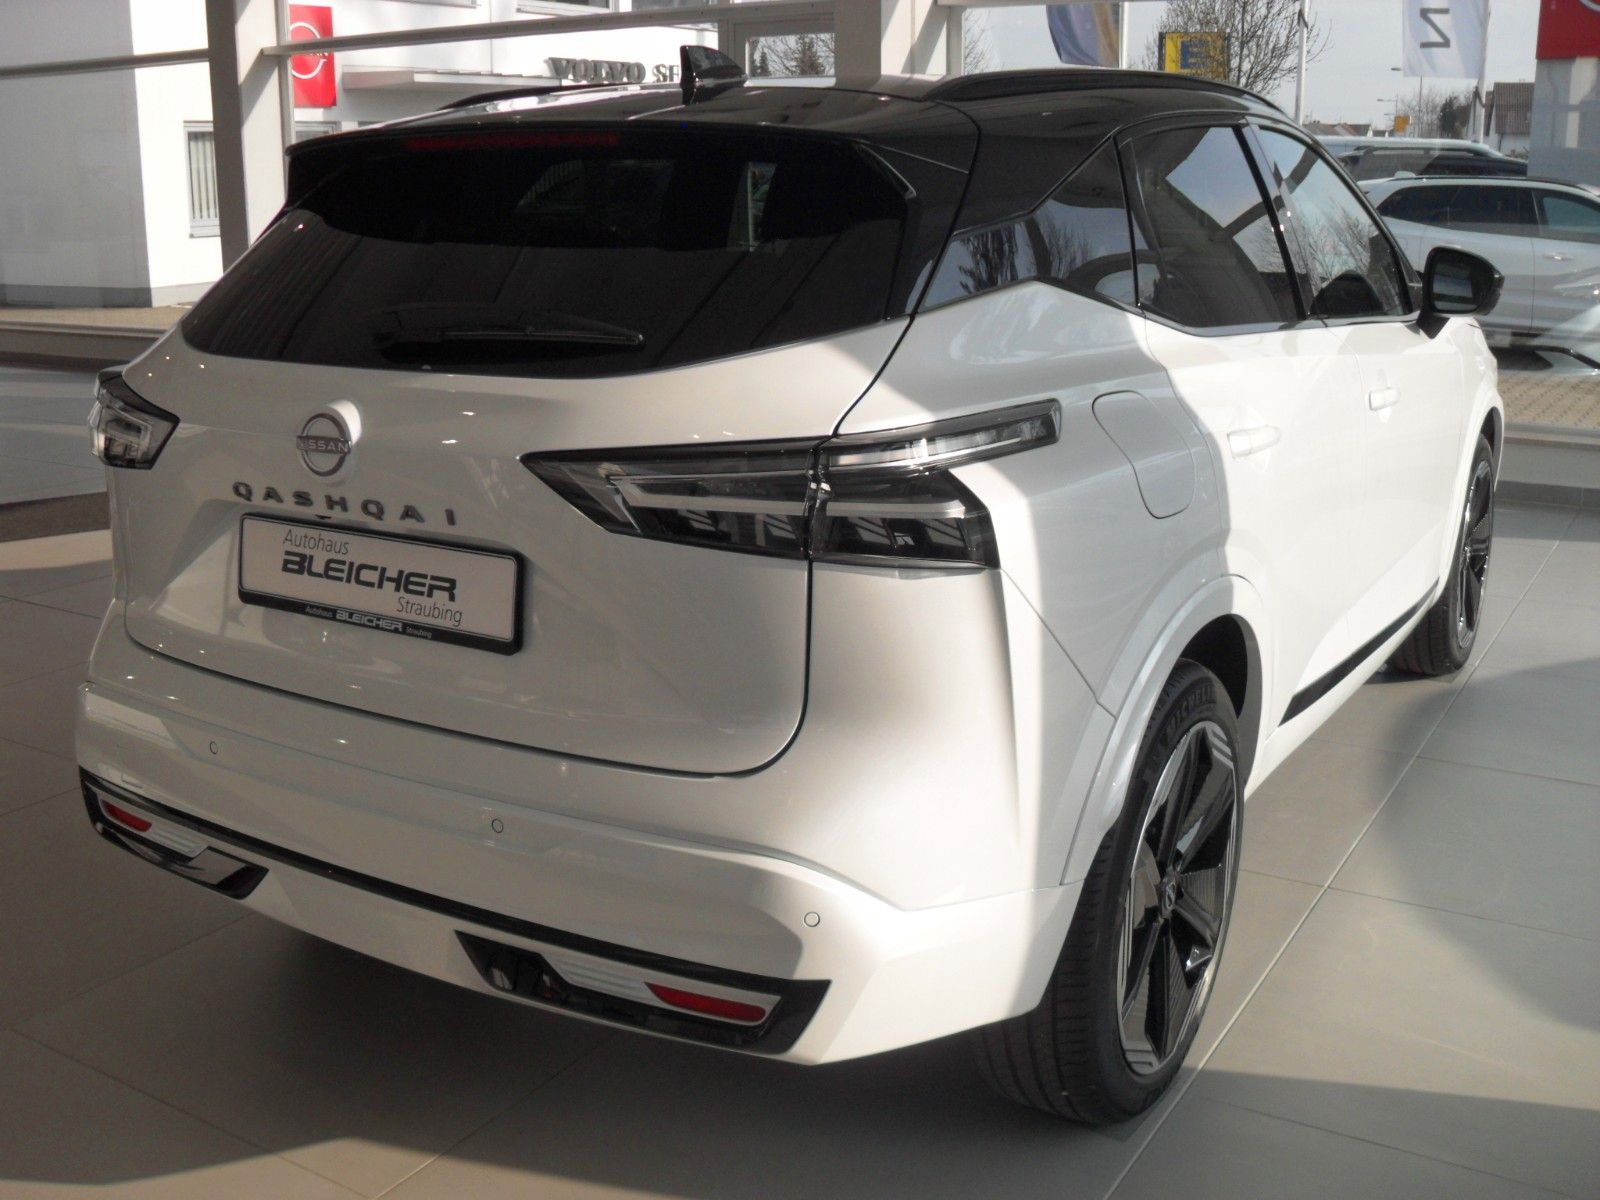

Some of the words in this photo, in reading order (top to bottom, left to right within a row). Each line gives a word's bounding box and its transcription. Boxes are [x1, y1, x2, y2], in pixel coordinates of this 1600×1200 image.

[544, 57, 646, 83] VOLVO
[297, 437, 349, 453] NISSAN
[232, 481, 456, 526] QASHQAI
[283, 529, 349, 556] Autohaus
[282, 550, 457, 602] BLEICHER
[336, 610, 403, 632] BLEICHER
[397, 596, 463, 627] Straubing
